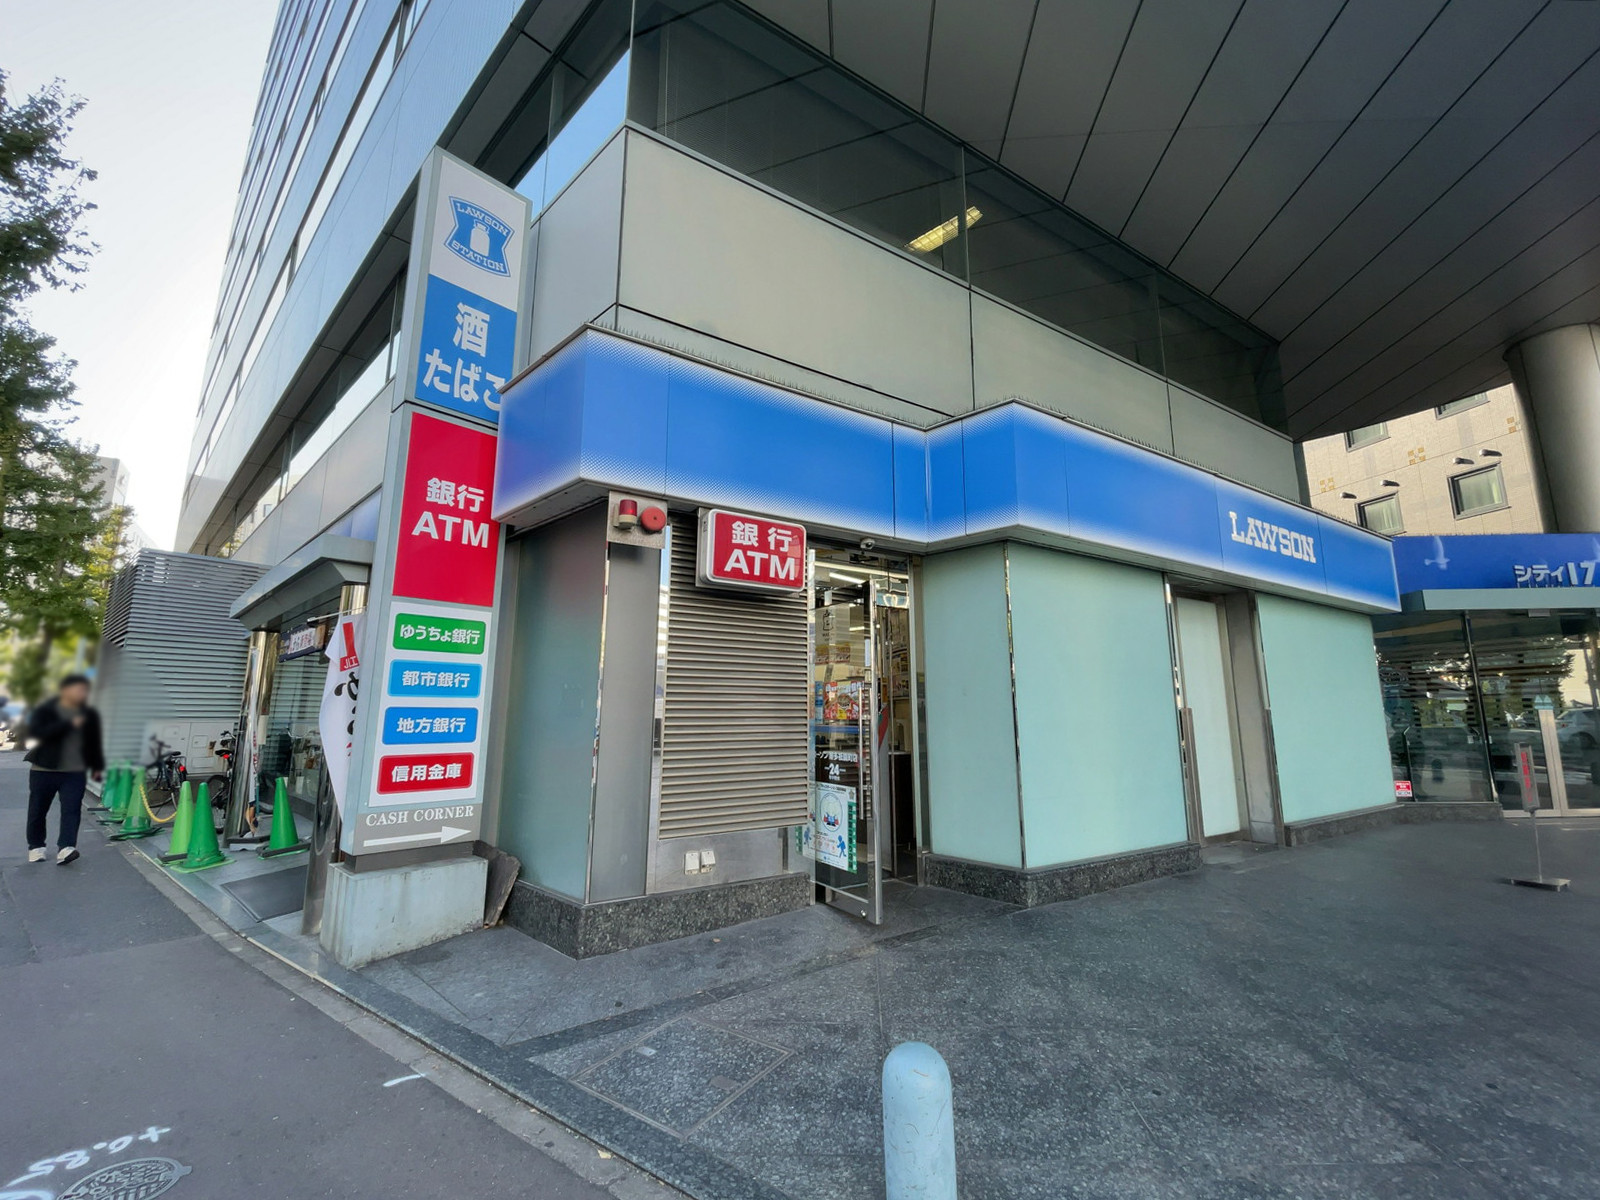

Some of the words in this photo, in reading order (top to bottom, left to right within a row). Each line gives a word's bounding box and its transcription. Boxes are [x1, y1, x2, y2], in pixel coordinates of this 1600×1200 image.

[456, 202, 509, 237] LAWSON
[451, 240, 505, 272] STATION
[452, 302, 490, 358] 酒
[422, 348, 506, 411] たばこ
[425, 477, 484, 513] 銀行
[411, 511, 490, 548] ATM
[731, 520, 793, 552] 銀行
[1229, 511, 1317, 564] LAWSON
[724, 549, 795, 581] ATM
[400, 623, 481, 646] ゆうちょ銀行
[402, 670, 471, 689] 都市銀行
[396, 716, 466, 734] 地方銀行
[391, 763, 462, 783] 信用金庫
[366, 811, 409, 826] CASH
[413, 805, 474, 822] CORNER
